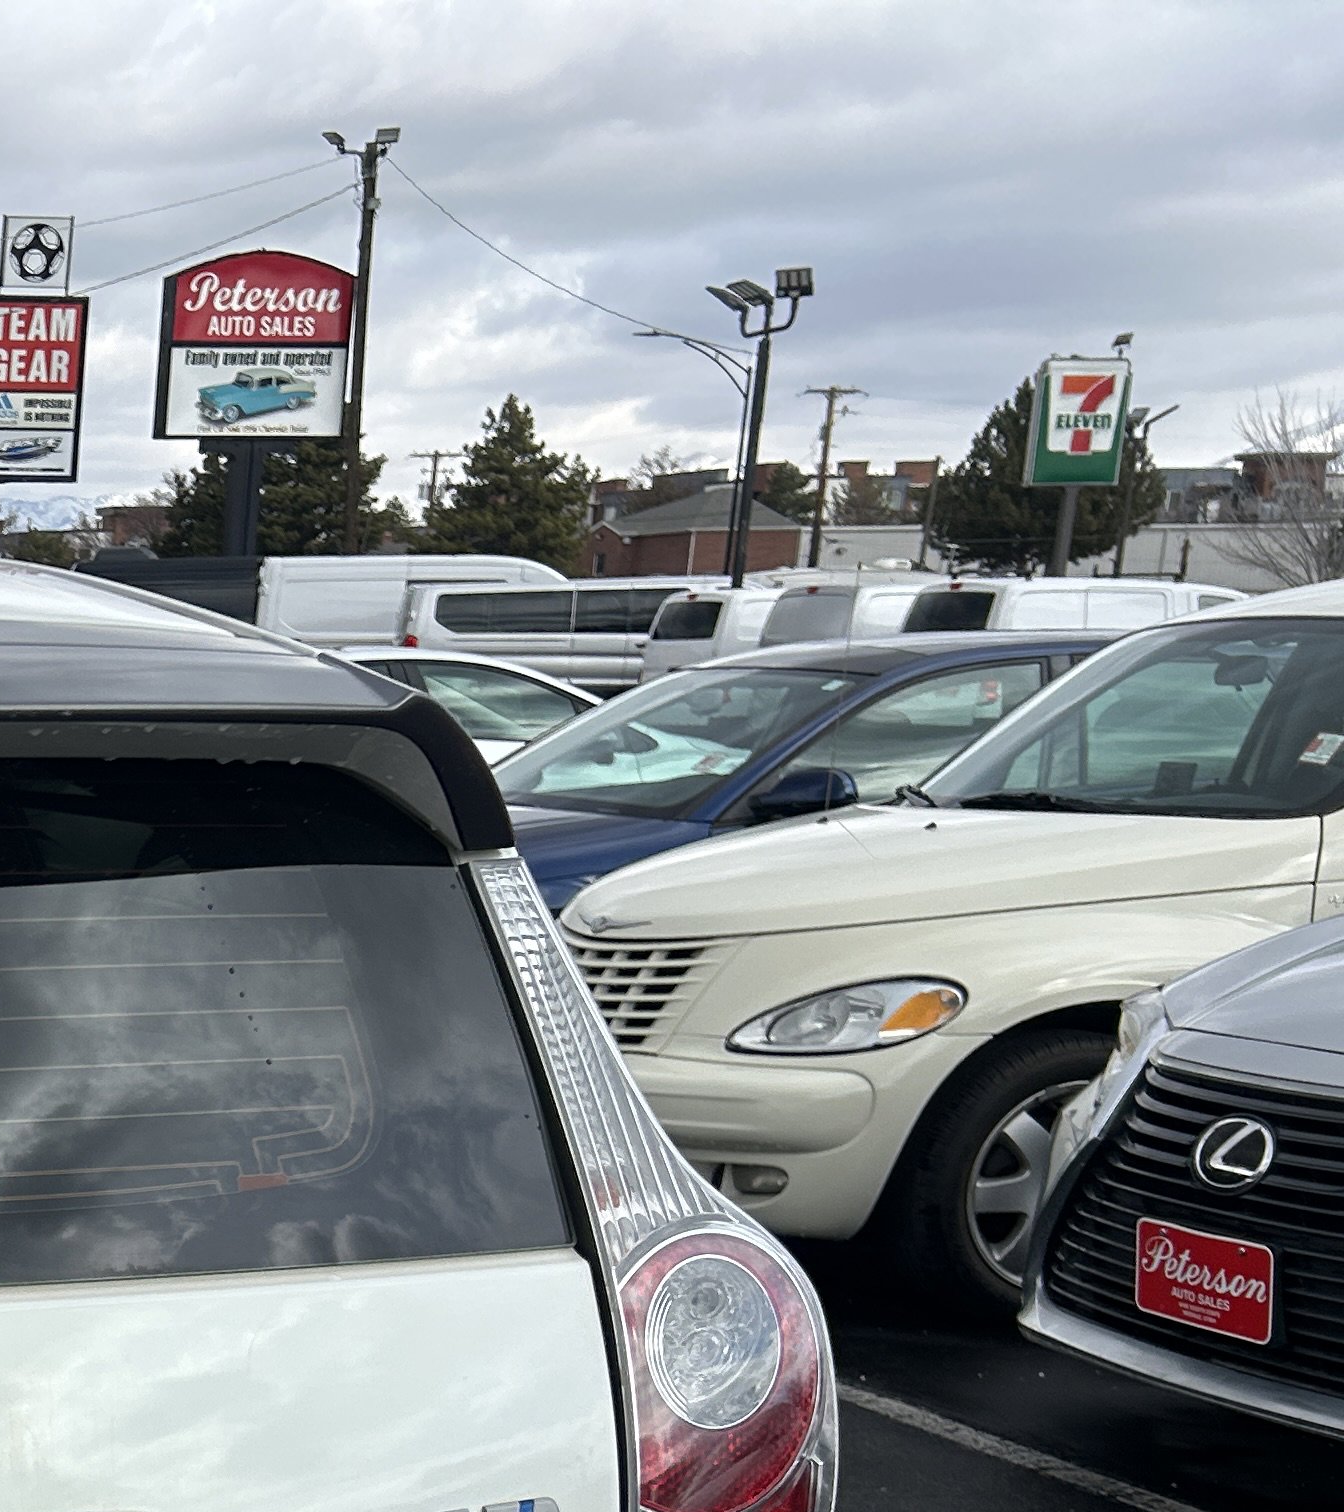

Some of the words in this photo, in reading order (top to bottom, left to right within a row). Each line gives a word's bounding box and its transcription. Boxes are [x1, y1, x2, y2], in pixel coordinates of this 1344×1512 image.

[183, 271, 342, 313] Peterson
[207, 315, 255, 337] AUTO
[259, 315, 316, 337] SALES
[1061, 374, 1116, 455] 7
[1141, 1236, 1267, 1304] Peterson
[1170, 1286, 1196, 1303] AUTO
[1197, 1292, 1230, 1312] SALES
